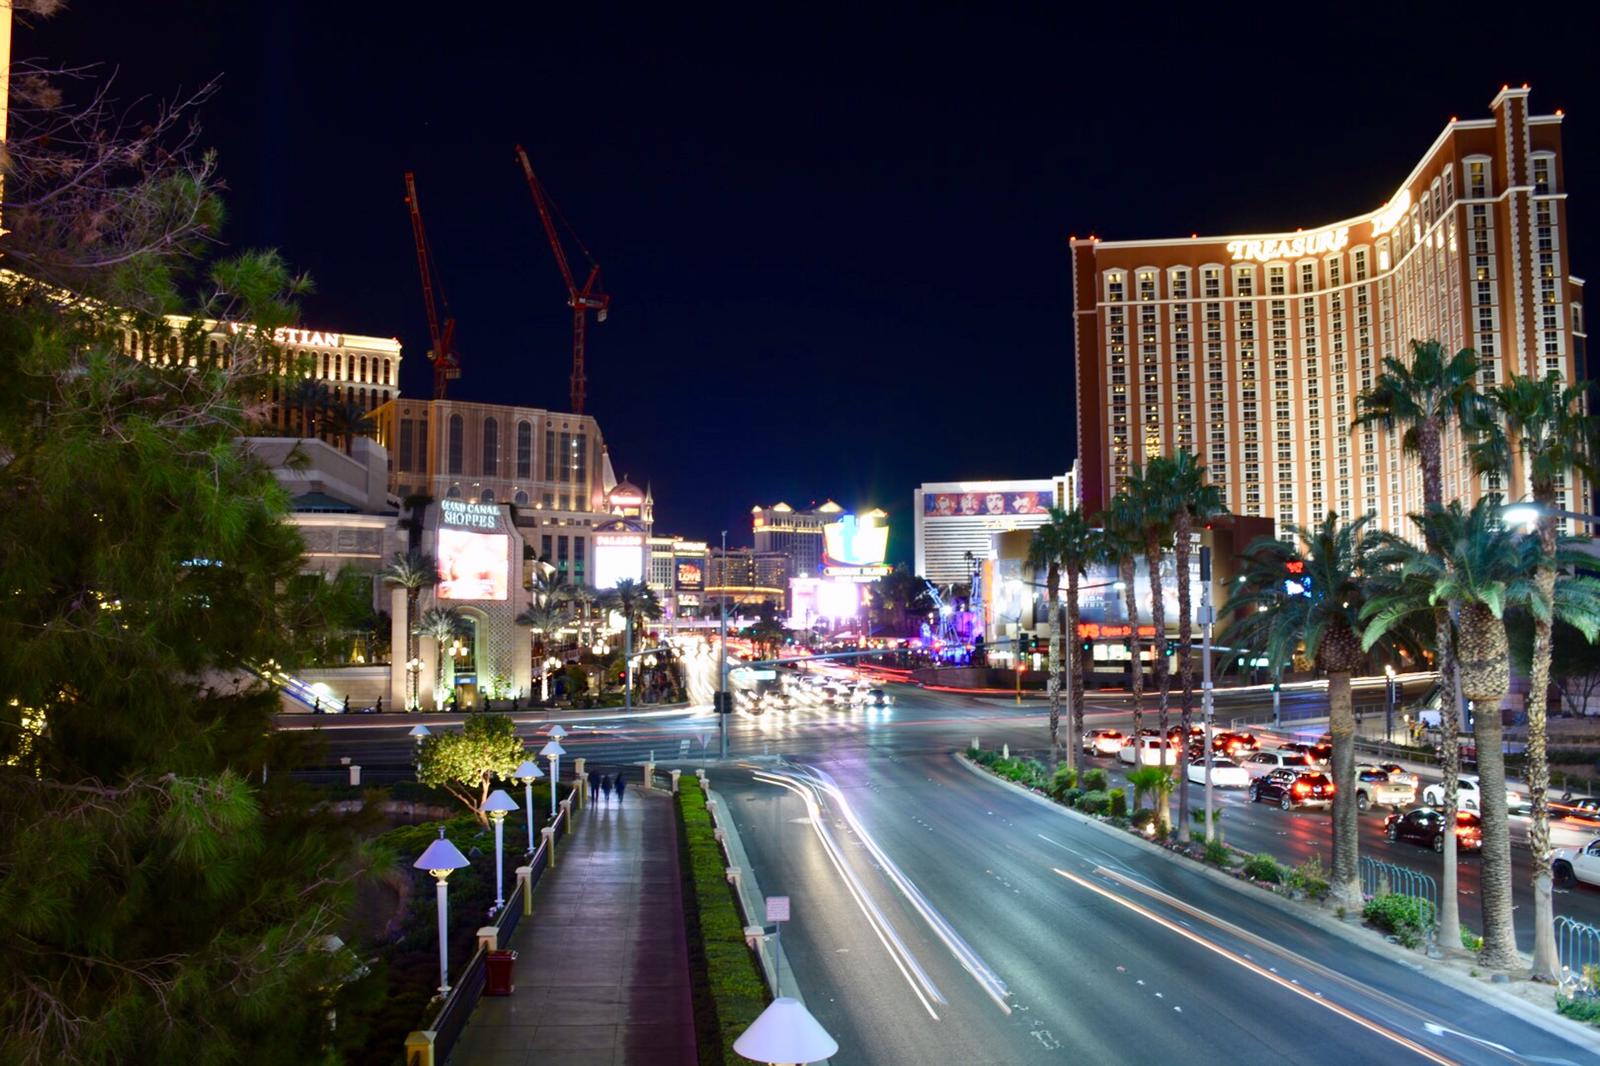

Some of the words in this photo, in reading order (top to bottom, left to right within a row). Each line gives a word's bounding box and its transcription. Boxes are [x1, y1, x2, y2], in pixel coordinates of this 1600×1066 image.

[1226, 227, 1349, 262] TREASURE
[441, 499, 466, 513] GRAND
[467, 504, 500, 516] CANAL
[444, 511, 495, 528] SHOPPES
[1077, 624, 1100, 639] VS
